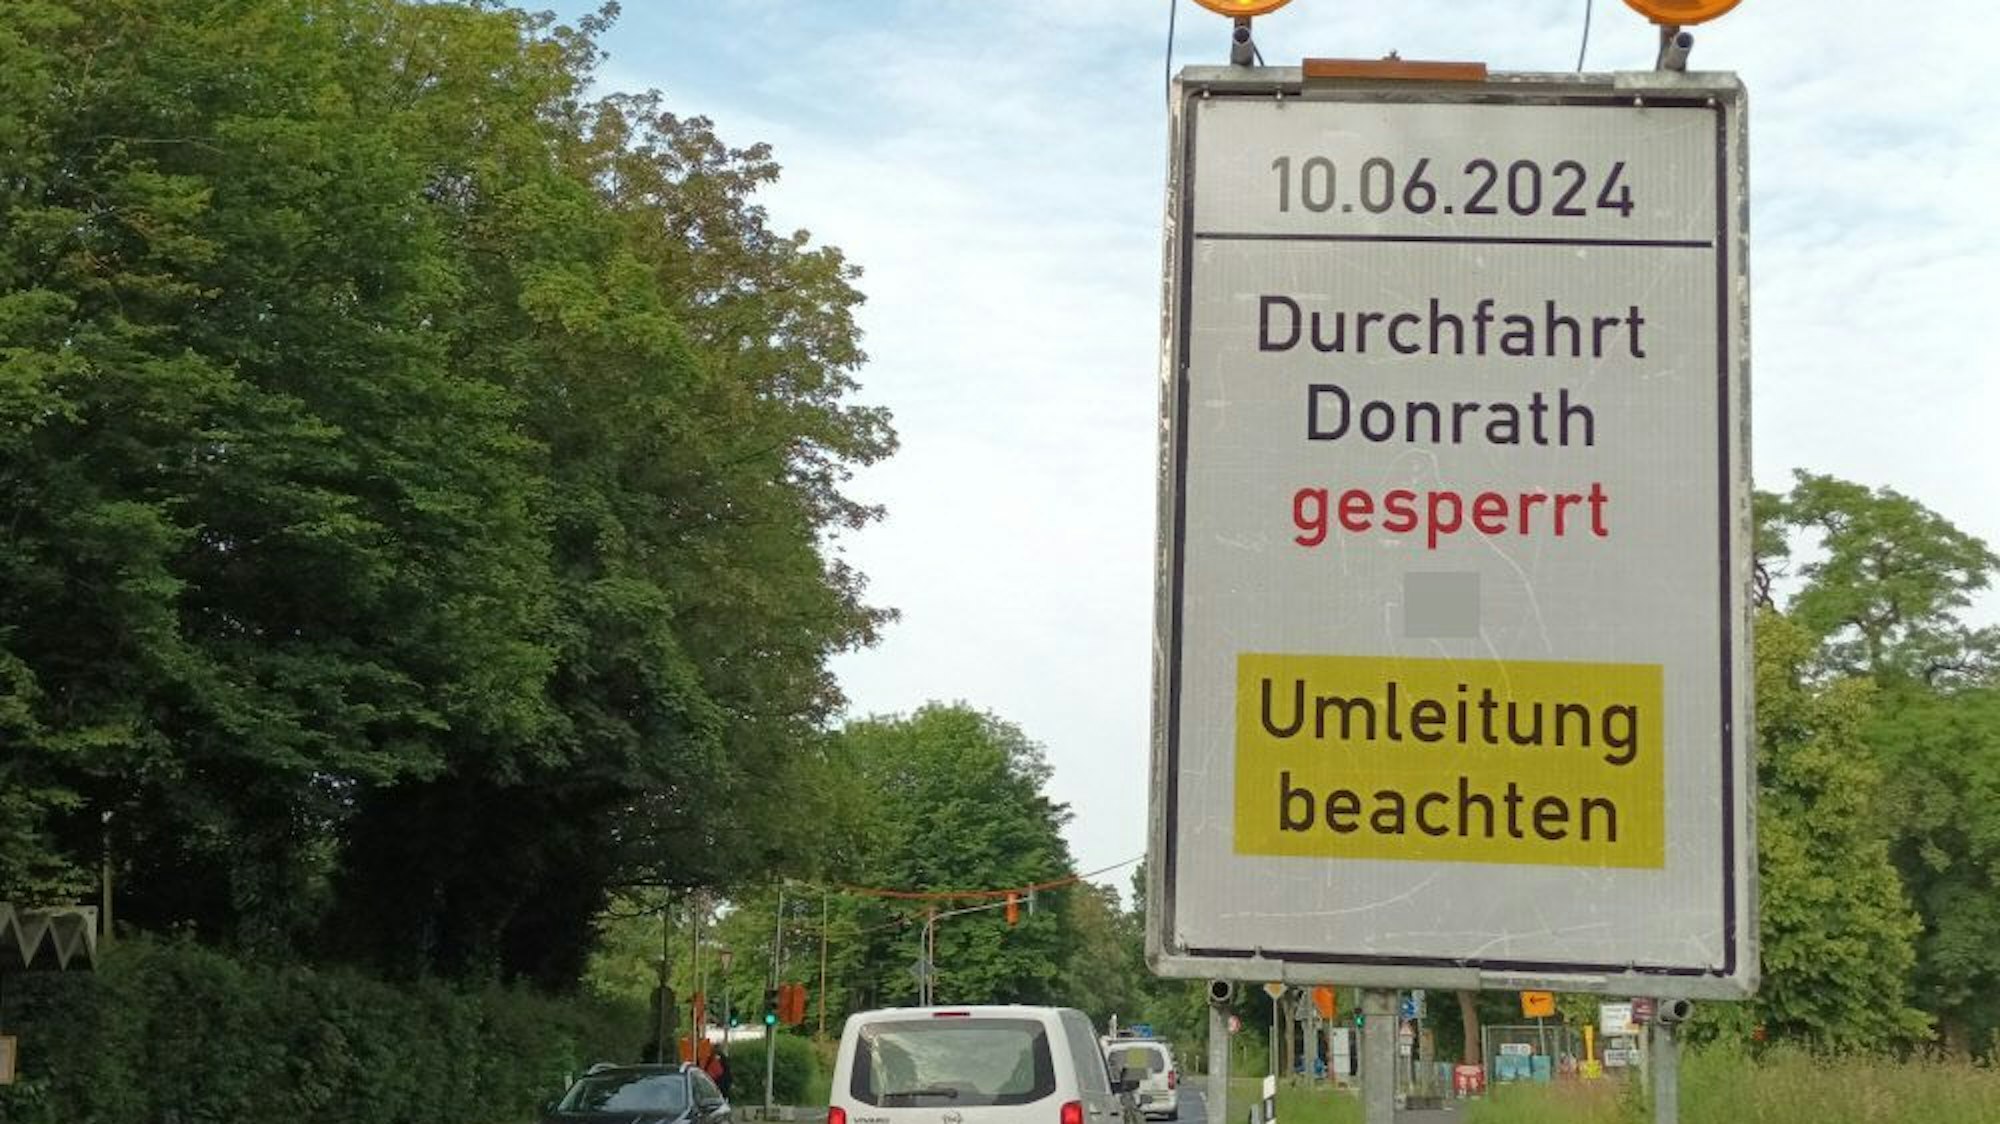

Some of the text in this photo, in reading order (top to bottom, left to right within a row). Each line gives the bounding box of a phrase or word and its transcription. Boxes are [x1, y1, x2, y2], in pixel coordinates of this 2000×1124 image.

[1271, 156, 1635, 218] 10.06.2024
[1258, 295, 1646, 359] Durchfahrt
[1306, 383, 1595, 446] Donrath
[1292, 483, 1608, 550] gesperrt
[1261, 678, 1638, 766] Umleitung
[1279, 771, 1617, 842] beachten
